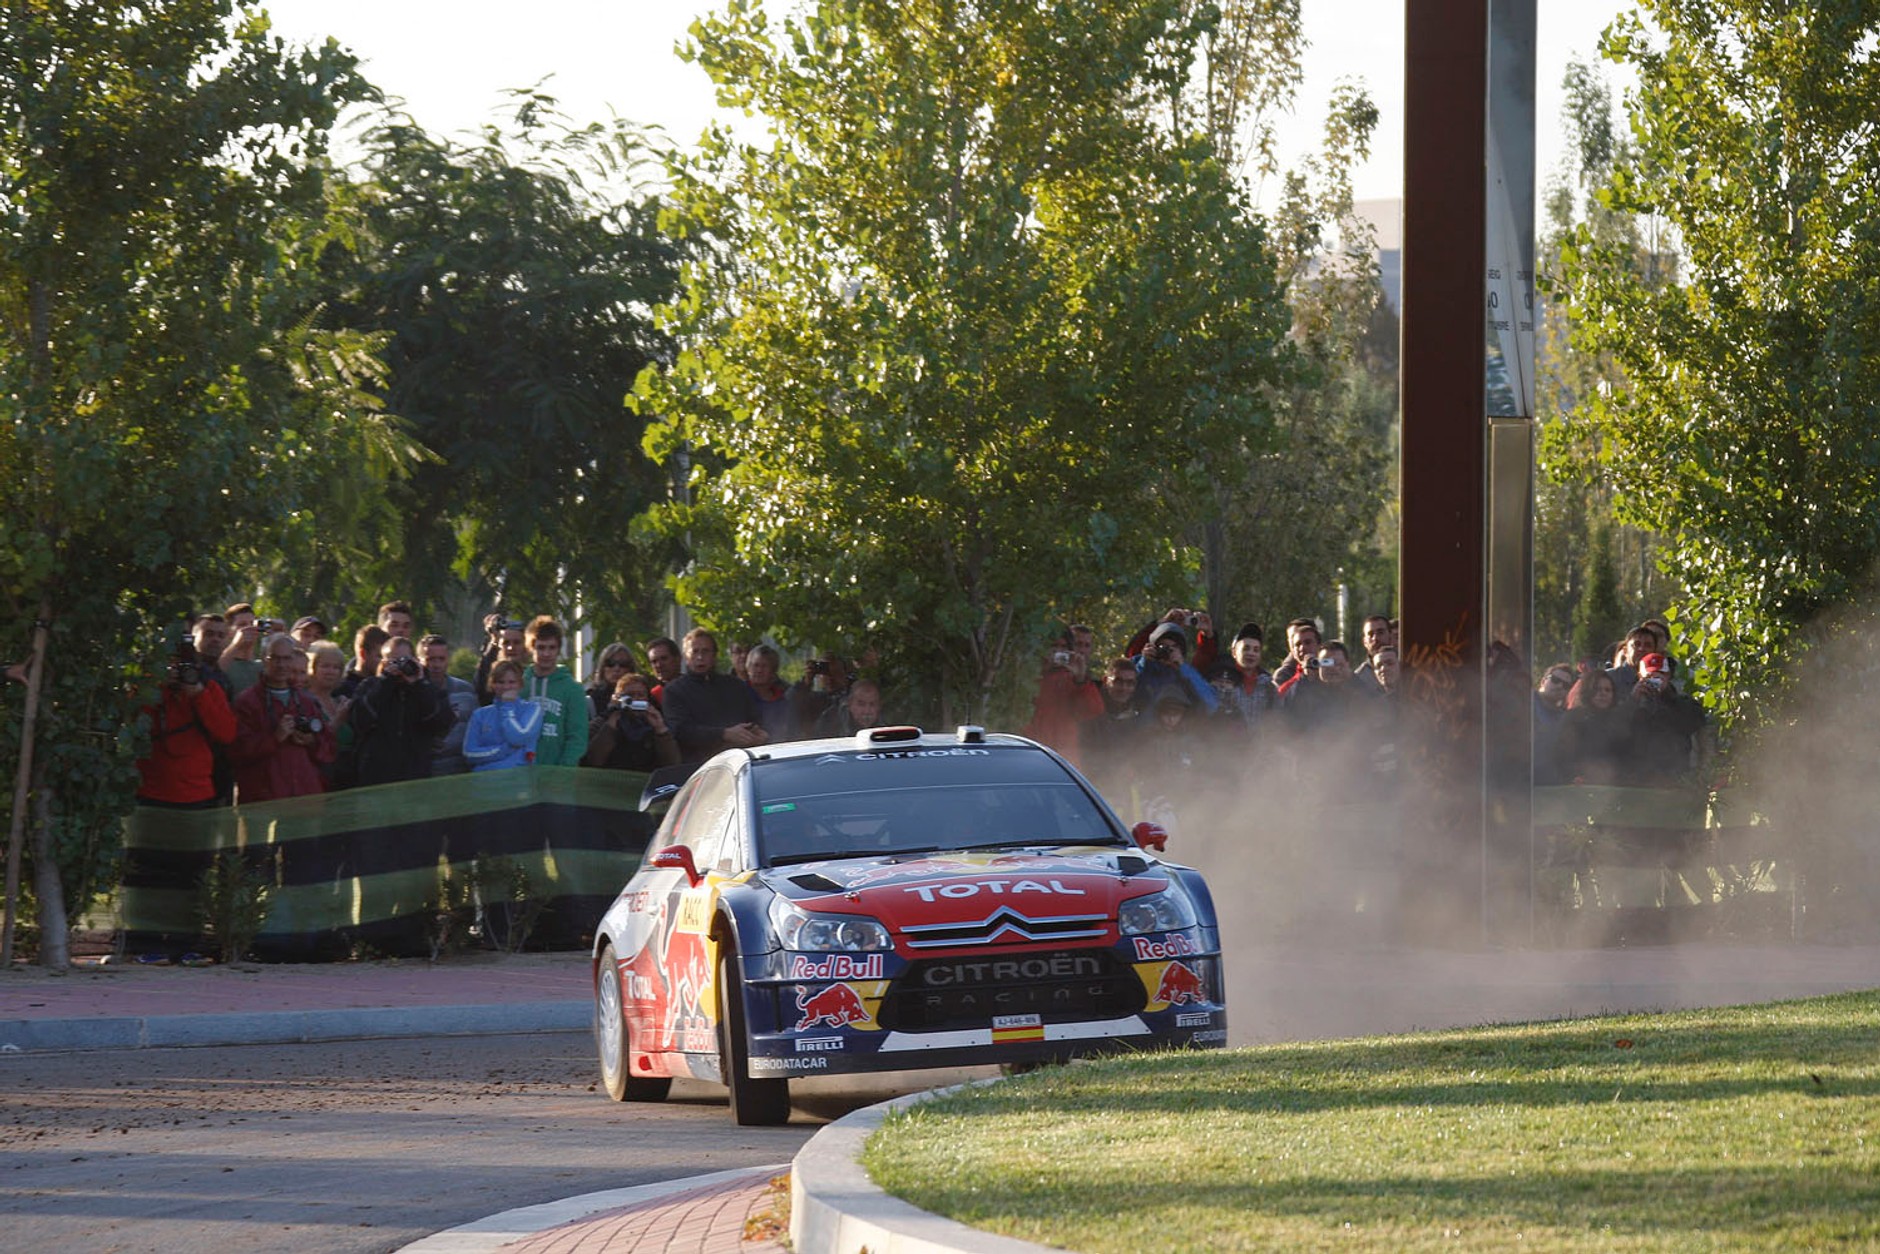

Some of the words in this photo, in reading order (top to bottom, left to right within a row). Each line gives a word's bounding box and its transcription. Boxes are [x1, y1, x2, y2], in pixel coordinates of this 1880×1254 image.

[904, 879, 1086, 902] TOTAL
[1133, 933, 1179, 960] Red
[791, 954, 834, 979] Red
[833, 953, 884, 979] Bull
[624, 970, 657, 1000] TOTAL
[795, 1036, 844, 1052] PIRELLI
[753, 1057, 828, 1070] EURODATACAR
